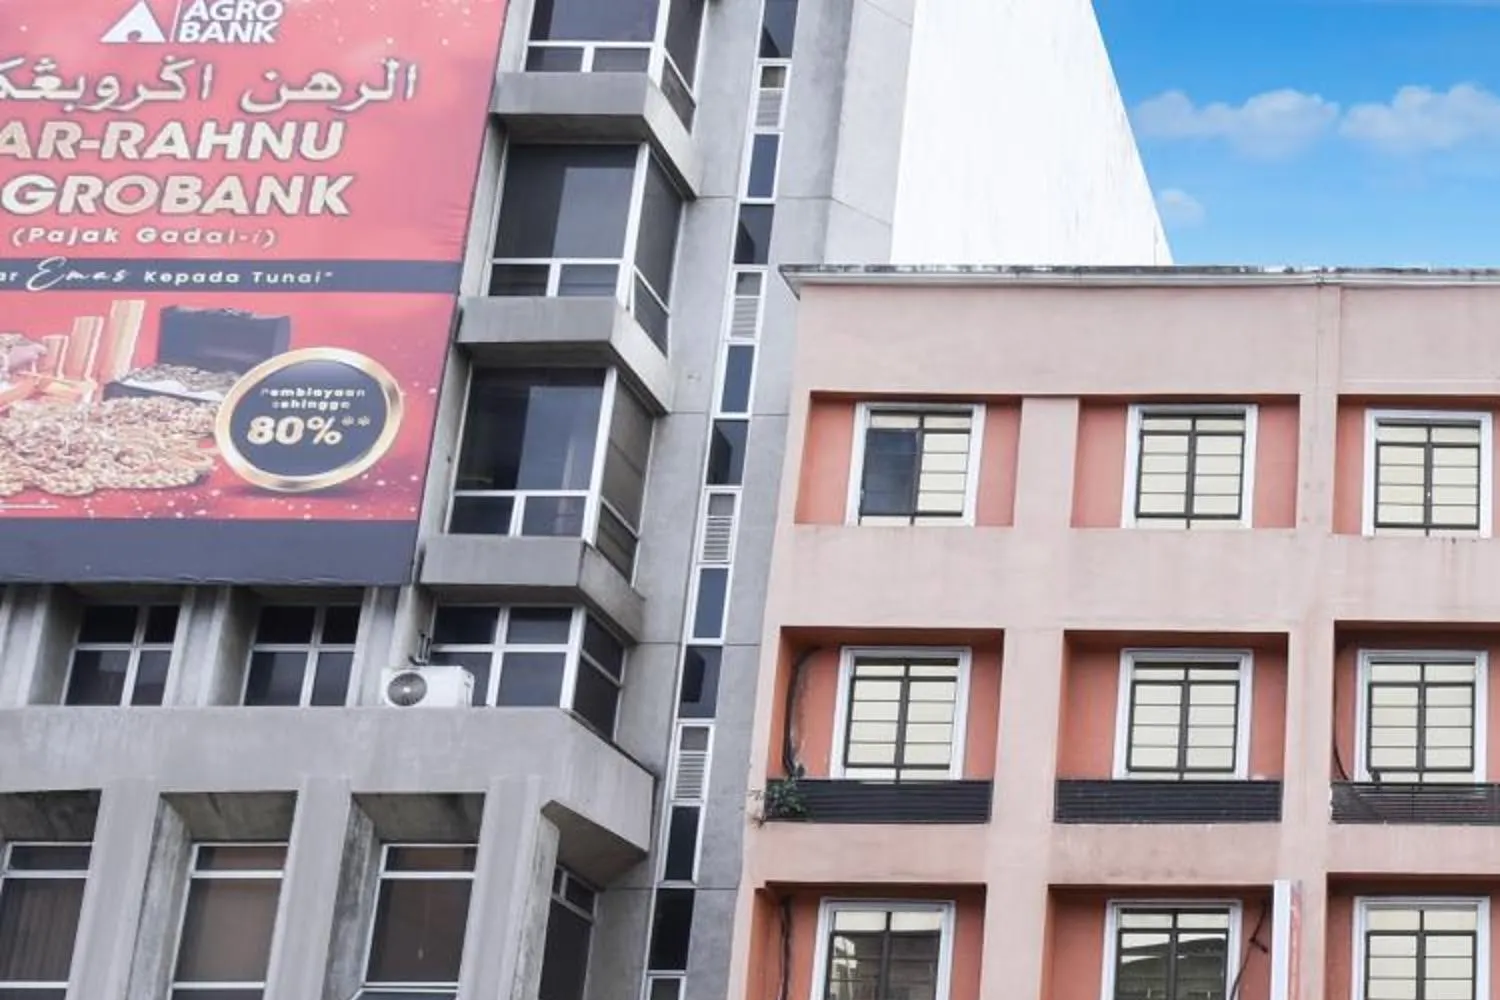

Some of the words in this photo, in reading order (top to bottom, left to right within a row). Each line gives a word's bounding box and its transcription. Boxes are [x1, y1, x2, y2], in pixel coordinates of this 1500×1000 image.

[183, 0, 283, 20] AGRO
[179, 21, 279, 43] BANK
[0, 120, 346, 160] AR-RAHNU
[0, 174, 355, 215] GROBANK
[144, 271, 241, 286] Kepada
